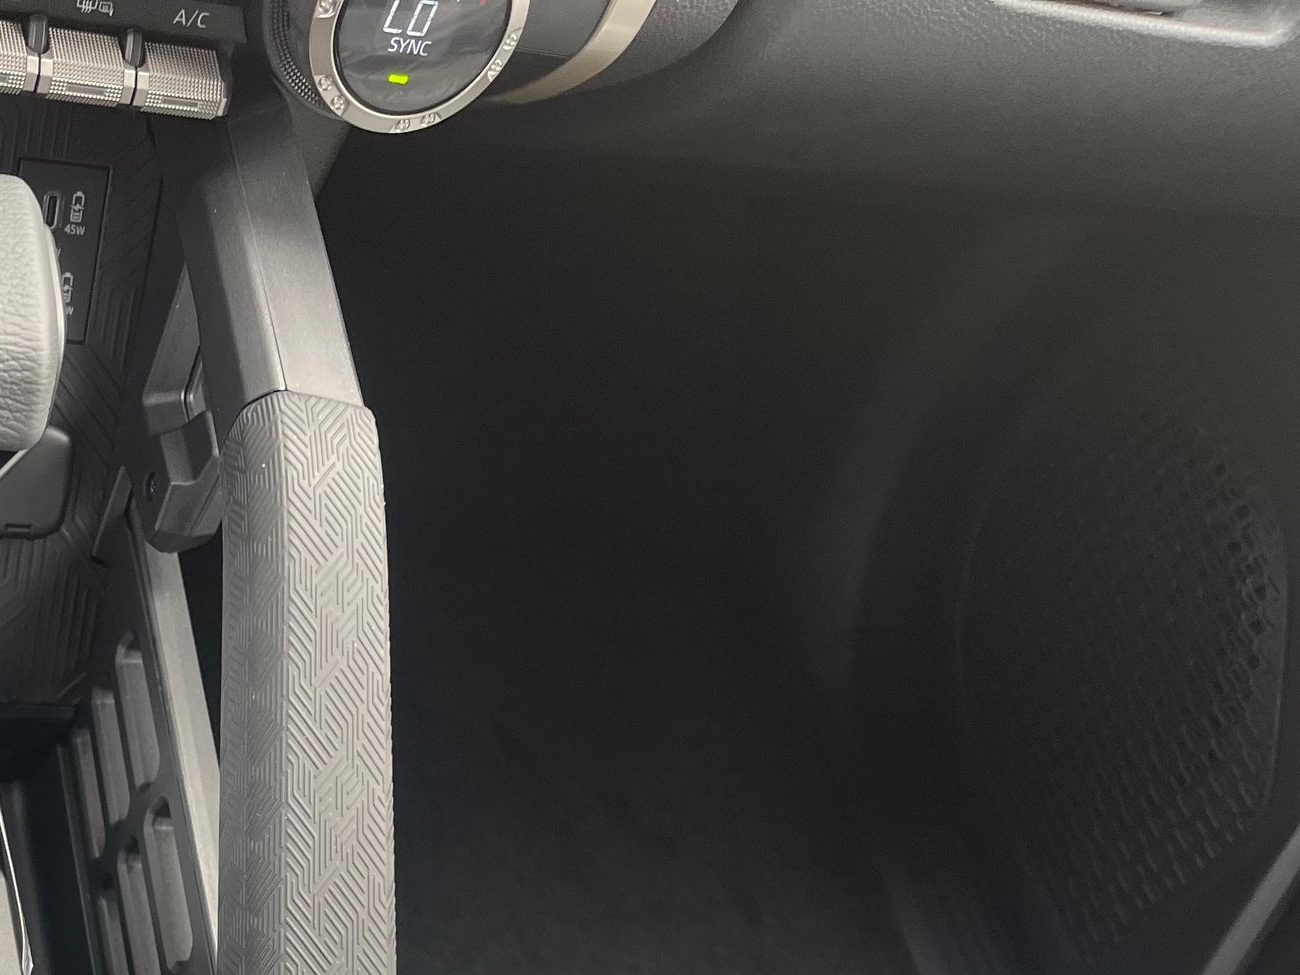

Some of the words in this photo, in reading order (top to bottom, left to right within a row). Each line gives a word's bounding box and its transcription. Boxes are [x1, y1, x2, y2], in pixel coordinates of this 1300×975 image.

[172, 8, 210, 29] A/C
[387, 36, 432, 56] SYNC
[63, 223, 86, 236] 45W
